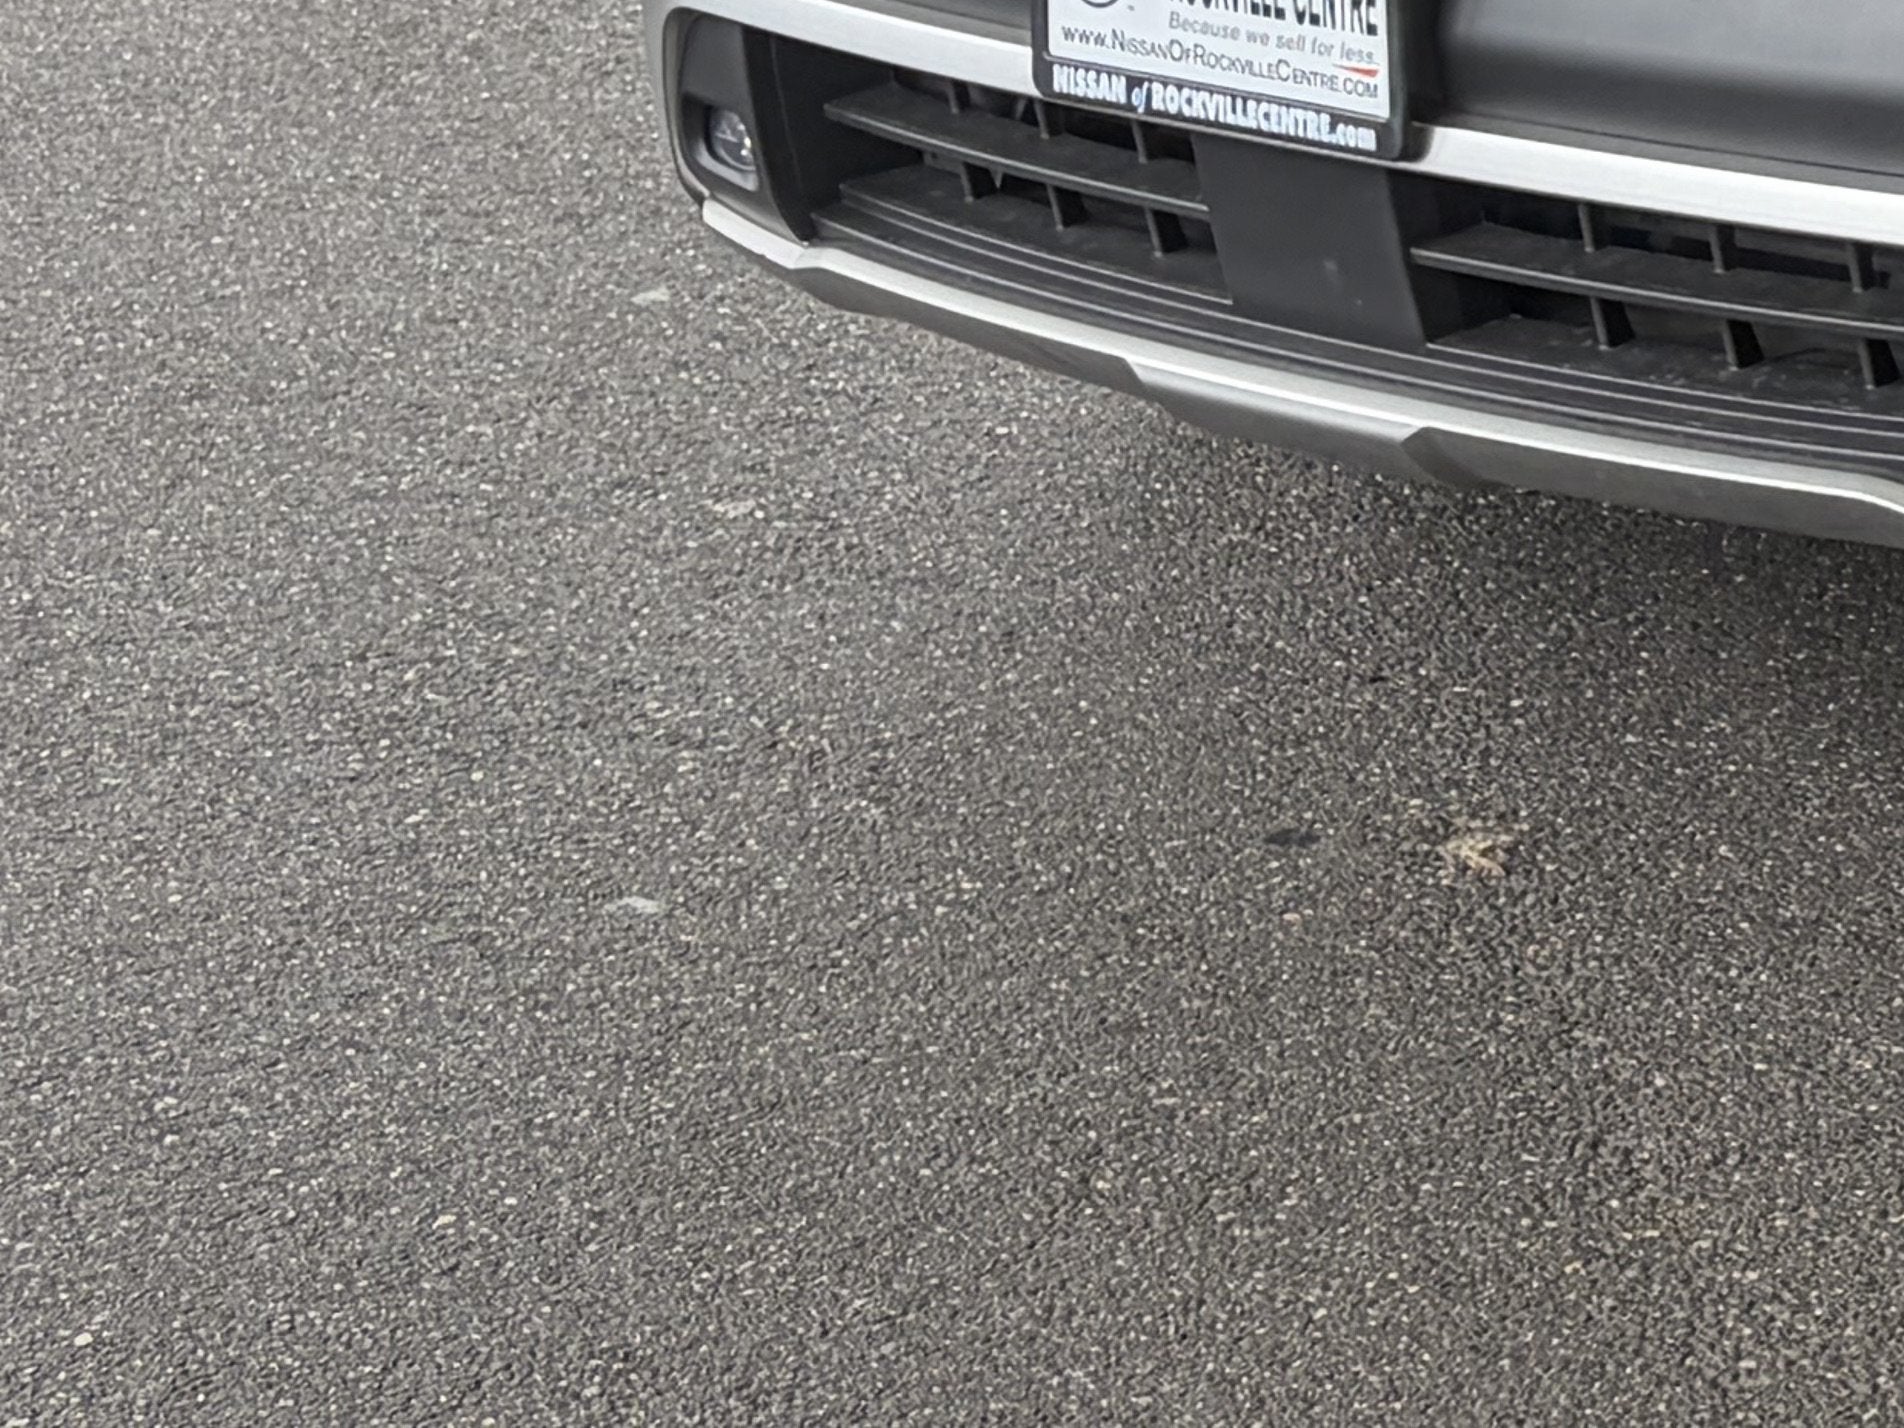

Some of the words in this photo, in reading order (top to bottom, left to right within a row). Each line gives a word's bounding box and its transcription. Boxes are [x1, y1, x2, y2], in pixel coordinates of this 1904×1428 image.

[1169, 11, 1240, 42] Because
[1245, 27, 1270, 47] we
[1275, 28, 1306, 53] sell
[1311, 35, 1335, 59] for
[1052, 63, 1127, 104] NISSAN
[1131, 80, 1149, 114] of
